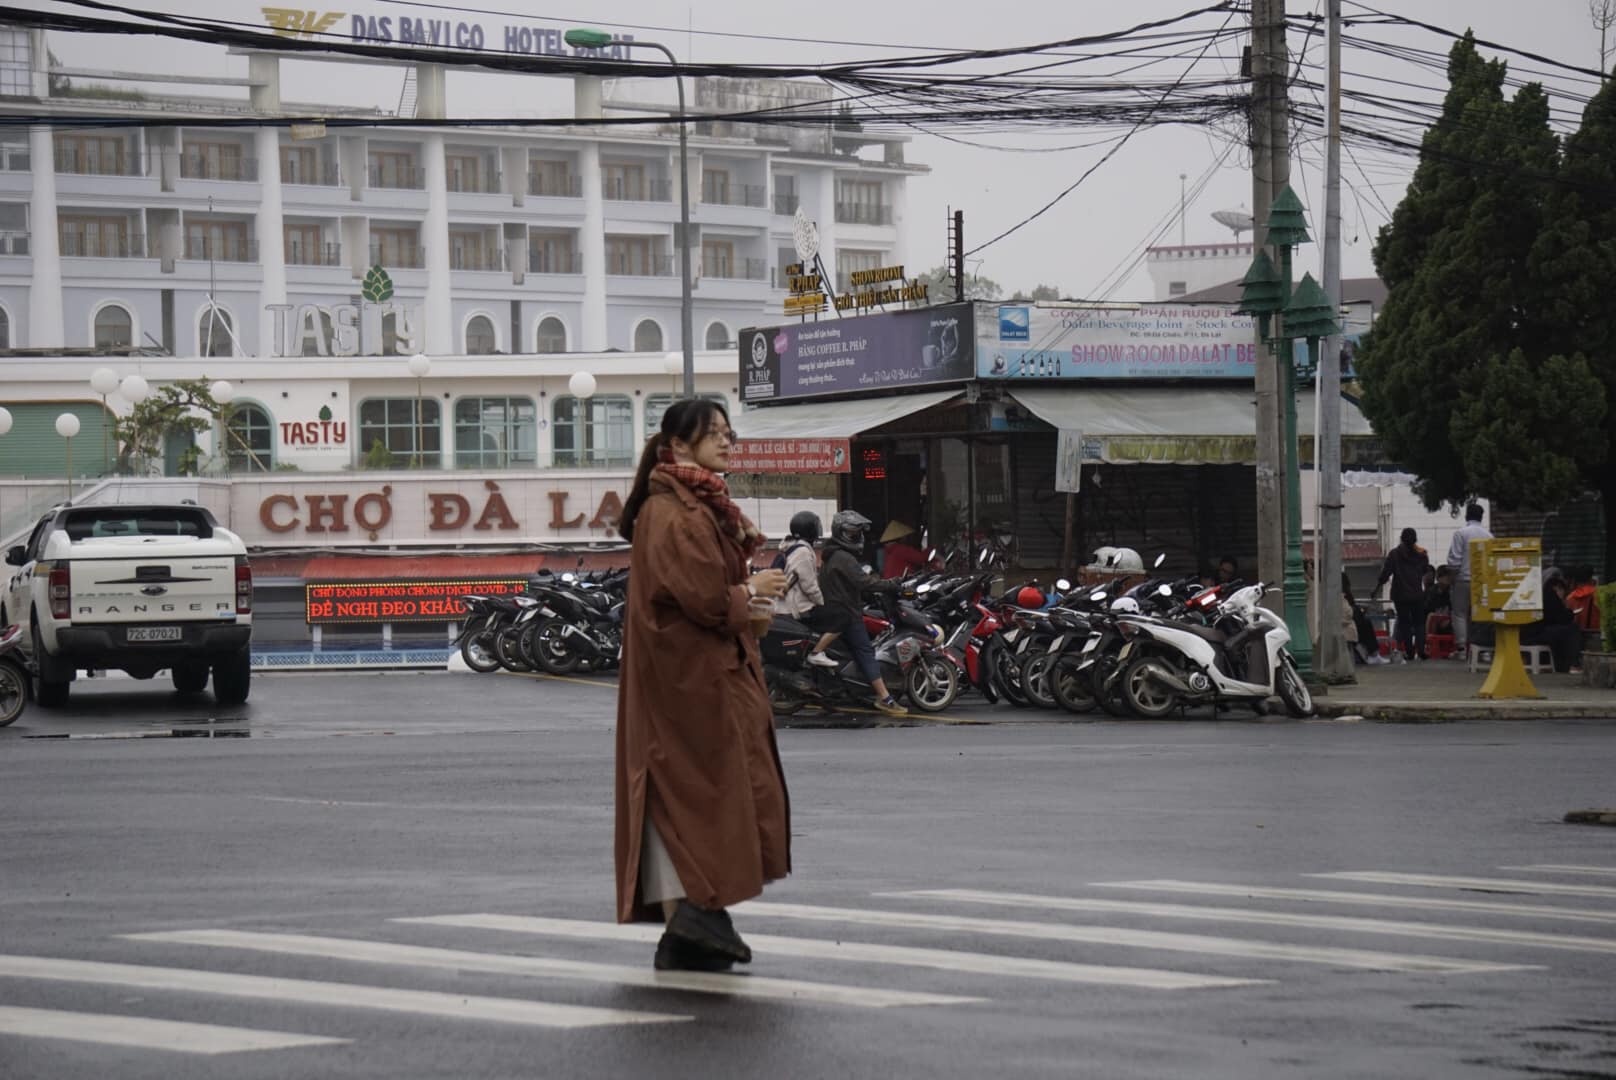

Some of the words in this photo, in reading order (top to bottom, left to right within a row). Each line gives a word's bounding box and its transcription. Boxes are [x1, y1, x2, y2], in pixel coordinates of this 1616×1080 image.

[352, 14, 393, 45] DAS
[504, 25, 567, 57] HOTEL
[851, 266, 904, 286] SHOWROOM
[264, 303, 427, 357] TASTY
[1062, 319, 1093, 329] Dalat
[1099, 319, 1152, 331] Beverage
[1155, 319, 1183, 329] Joint
[1195, 319, 1228, 329] Stock
[816, 342, 842, 355] COFFEE
[1071, 344, 1176, 364] SHOWROOM
[1178, 343, 1232, 364] DALAT
[279, 421, 346, 445] TASTY
[259, 484, 391, 542] CHỢ
[428, 480, 520, 531] ĐÀ
[335, 586, 367, 598] ĐỘNG
[369, 584, 400, 597] PHÒNG
[445, 584, 472, 597] DỊCH
[474, 584, 507, 595] COVID
[79, 602, 230, 615] RANGER
[336, 601, 378, 618] NGHỊ
[381, 601, 416, 616] ĐEO
